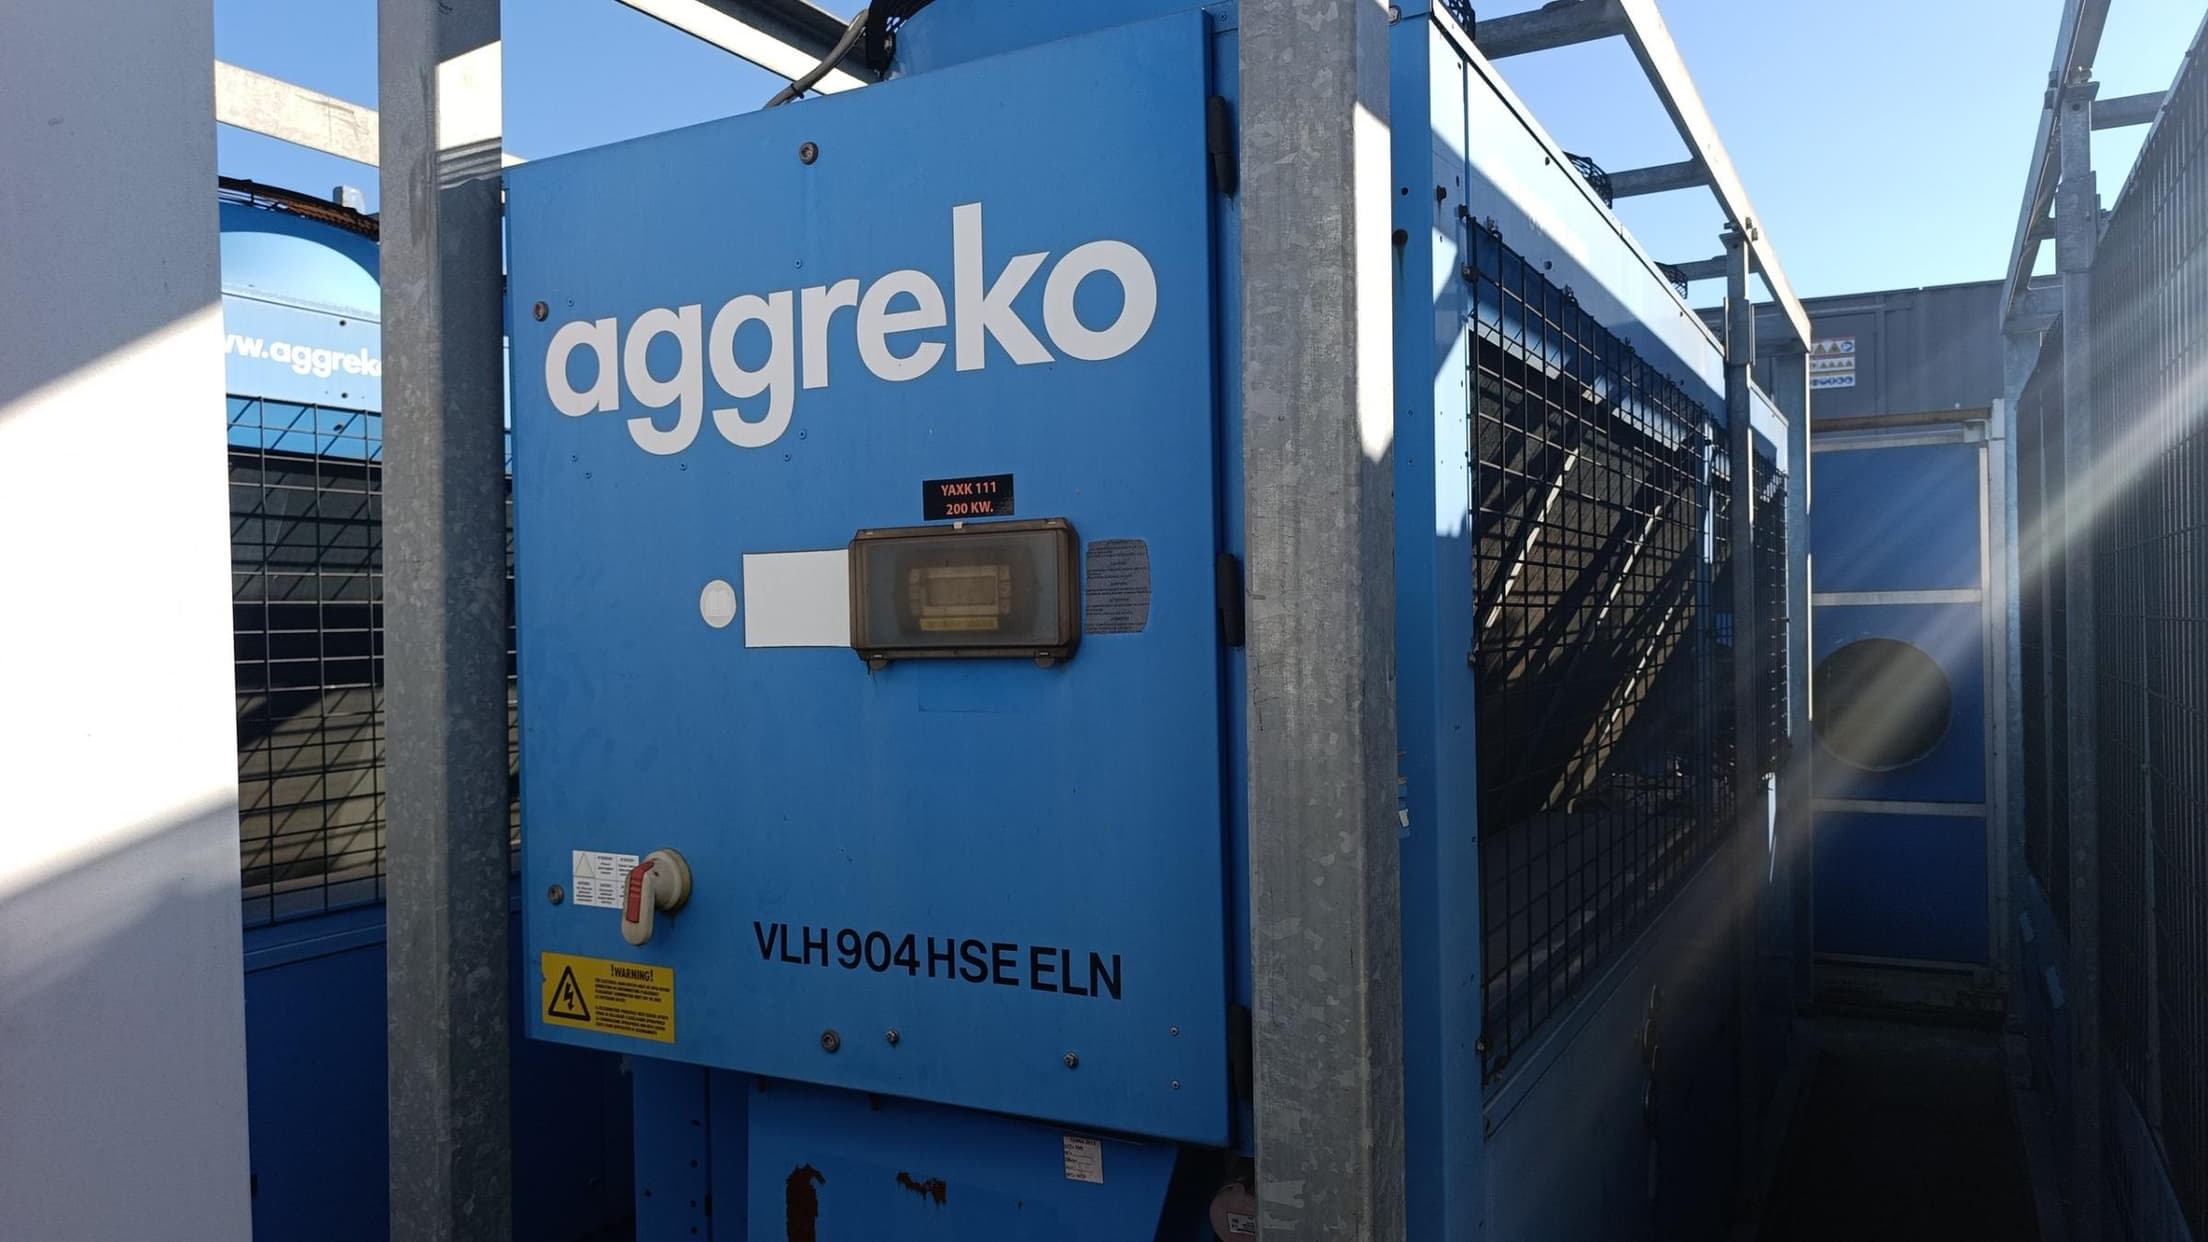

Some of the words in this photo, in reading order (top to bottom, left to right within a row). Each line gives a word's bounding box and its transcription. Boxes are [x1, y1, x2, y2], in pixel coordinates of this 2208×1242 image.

[545, 202, 1157, 456] aggreko
[224, 333, 382, 379] w.aggrek
[941, 482, 973, 497] YAXK
[976, 481, 997, 495] 111
[946, 503, 968, 515] 200
[971, 500, 994, 514] KW.
[610, 964, 654, 983] !WARNING!
[753, 920, 829, 967] VLH
[836, 928, 921, 977] 904
[927, 936, 1020, 987] HSE
[1029, 945, 1122, 1001] ELN
